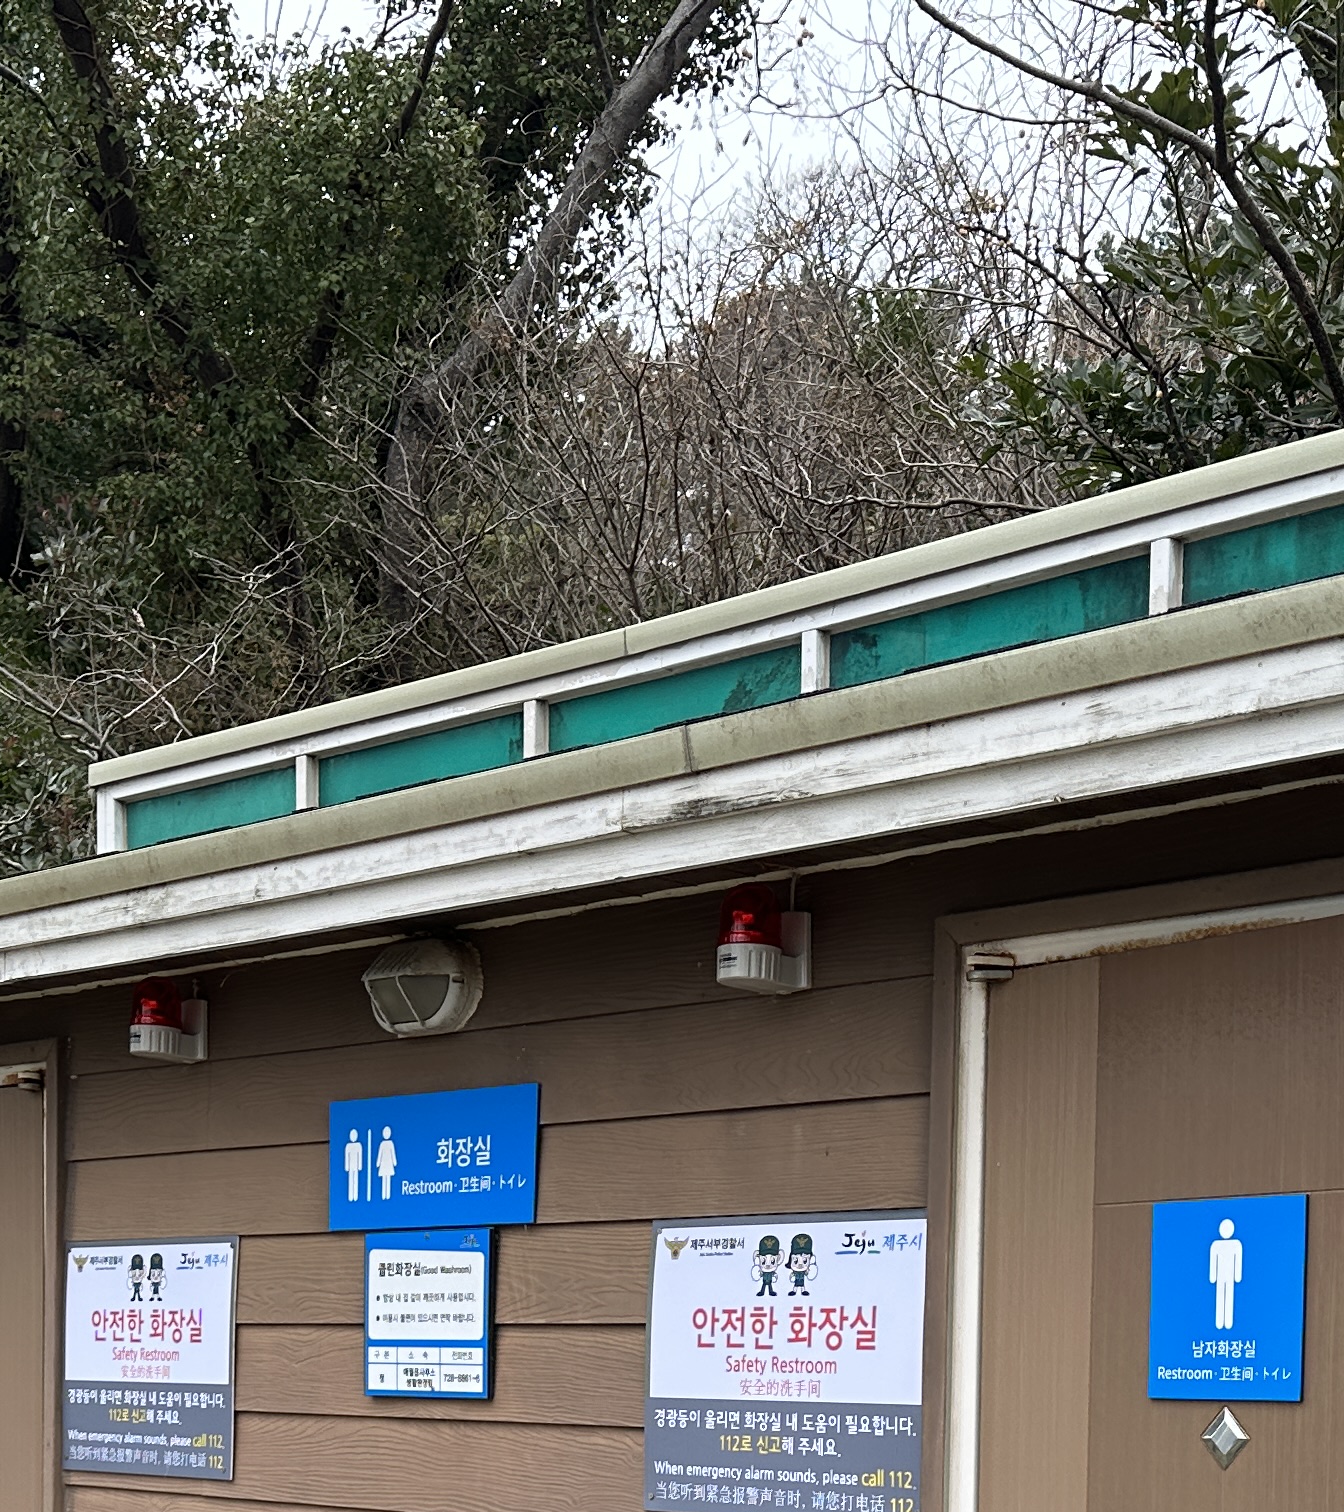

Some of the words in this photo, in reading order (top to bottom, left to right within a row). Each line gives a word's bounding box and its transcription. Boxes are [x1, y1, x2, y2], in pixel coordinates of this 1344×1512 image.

[436, 1134, 491, 1168] 화장실
[402, 1179, 453, 1195] Restroom
[458, 1175, 491, 1193] 卫生间
[499, 1173, 526, 1190] トイレ
[690, 1237, 745, 1250] 제주서부경찰서
[842, 1230, 875, 1255] Jeju
[882, 1233, 922, 1251] 제주시
[204, 1252, 229, 1267] 제주시
[91, 1309, 144, 1343] 안전한
[149, 1308, 203, 1343] 화장실
[692, 1306, 778, 1350] 안전한
[787, 1305, 878, 1351] 화장실
[112, 1346, 137, 1363] Safety
[140, 1347, 179, 1361] Restroom
[1192, 1340, 1256, 1358] 남자화장실
[725, 1354, 767, 1375] Safety
[771, 1356, 837, 1374] Restroom
[1157, 1366, 1213, 1380] Restroom
[1219, 1366, 1254, 1381] 卫生间
[1263, 1366, 1291, 1380] トイレ
[124, 1389, 147, 1406] 화장실
[149, 1391, 156, 1406] 내
[158, 1391, 182, 1407] 도움이
[740, 1378, 821, 1398] 安全的洗手间
[109, 1408, 129, 1422] 112로
[156, 1410, 182, 1425] 주세요.
[654, 1408, 701, 1428] 경광등이
[704, 1409, 740, 1429] 울리면
[744, 1411, 781, 1432] 화장실
[786, 1412, 797, 1431] 내
[802, 1413, 841, 1434] 도움이
[845, 1414, 916, 1436] 필요합니다.
[68, 1429, 87, 1440] When
[193, 1433, 207, 1447] call
[720, 1435, 753, 1451] 112로
[756, 1435, 794, 1455] 신고해
[798, 1437, 841, 1457] 주세요.
[654, 1460, 684, 1476] When
[686, 1464, 742, 1481] emergency
[744, 1465, 774, 1480] alarm
[777, 1468, 819, 1485] sounds,
[822, 1469, 858, 1486] please
[861, 1468, 884, 1487] call
[889, 1470, 917, 1490] 112.
